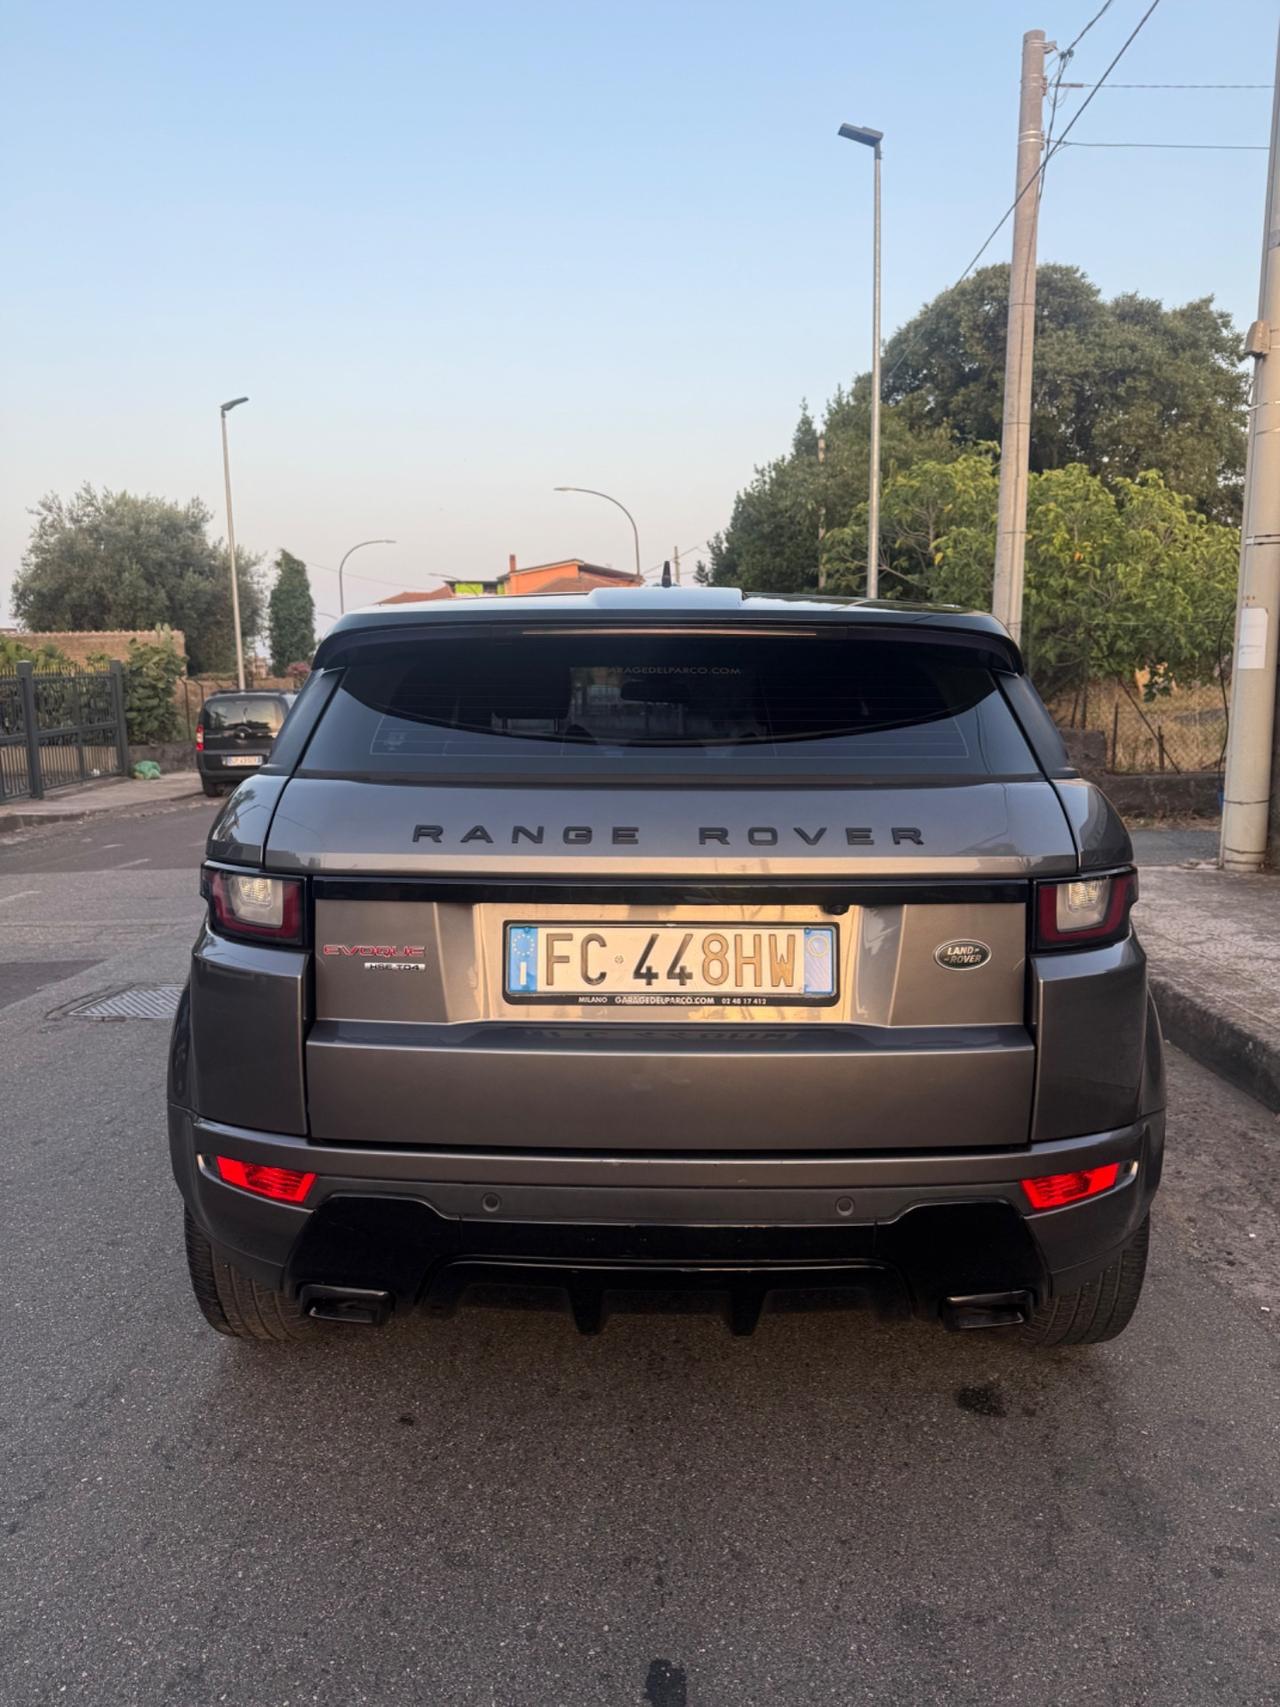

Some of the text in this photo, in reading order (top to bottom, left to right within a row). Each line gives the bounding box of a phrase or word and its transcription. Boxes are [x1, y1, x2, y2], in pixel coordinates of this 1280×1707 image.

[598, 667, 741, 675] ARAGEDELPARCO.COM
[412, 824, 924, 846] RANGE ROVER
[323, 944, 425, 958] EVOQUE
[947, 946, 974, 955] LAND
[545, 932, 797, 988] FC 448HW
[949, 955, 982, 964] ROVER
[578, 995, 608, 1003] MILANO
[614, 995, 716, 1005] GARAGEDELPARCO.COM
